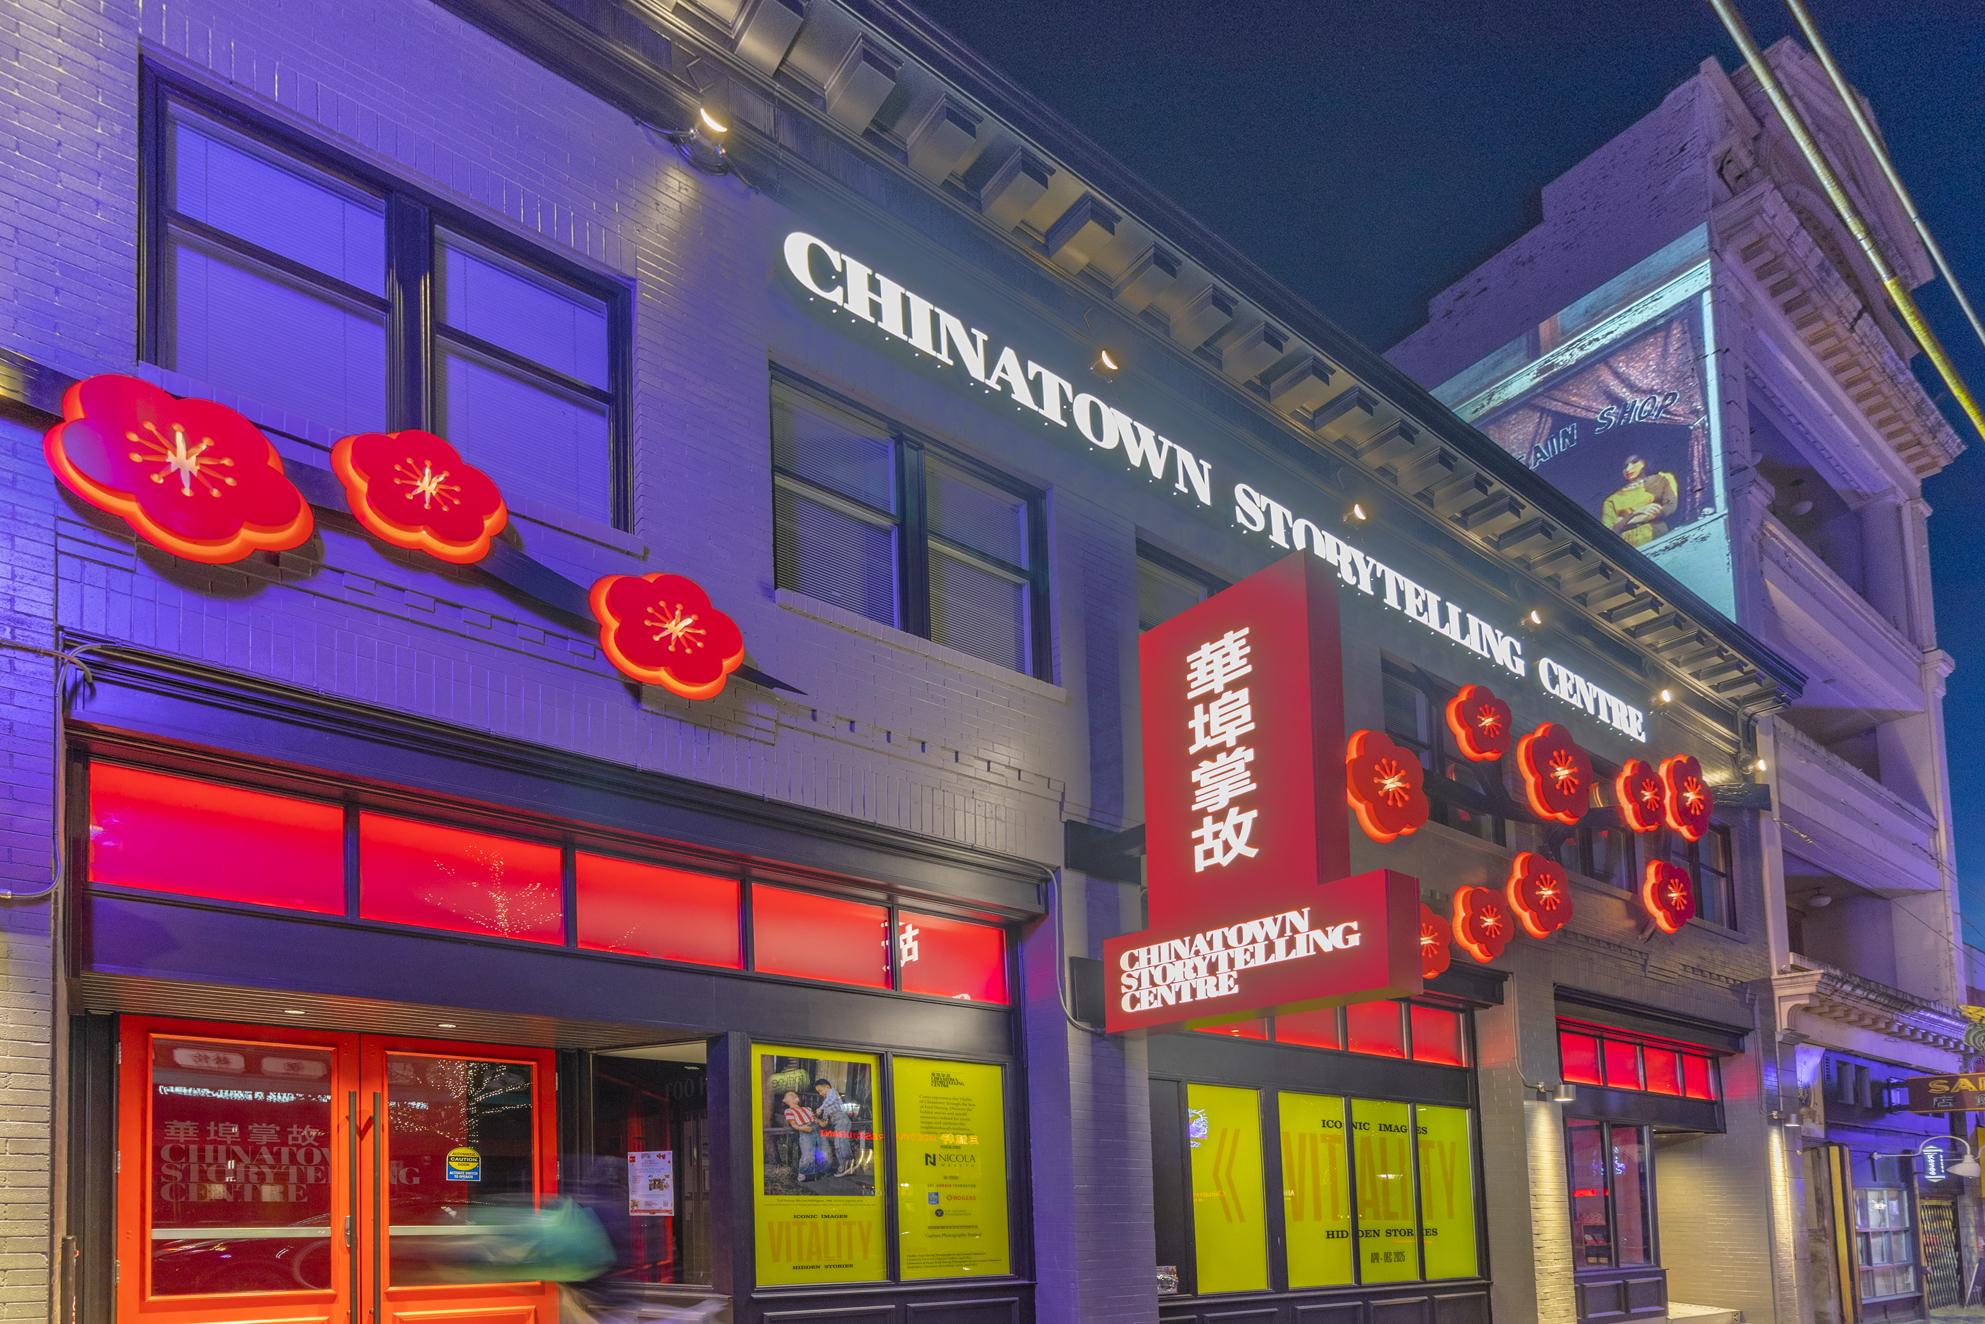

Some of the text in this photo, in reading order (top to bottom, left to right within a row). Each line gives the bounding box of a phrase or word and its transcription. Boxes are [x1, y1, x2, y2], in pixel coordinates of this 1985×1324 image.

[1594, 390, 1680, 434] SHOP
[783, 231, 1647, 744] CHINATOWN STORYTELLING CENTRE
[1186, 626, 1258, 873] 華埠掌故
[1119, 907, 1311, 973] CHINATOWN
[1120, 921, 1361, 994] STORYTELLING
[1120, 971, 1239, 1013] CENTRE
[163, 1119, 320, 1147] 華埠掌故
[160, 1143, 331, 1166] CHINATO
[939, 1154, 976, 1162] NICOLA
[160, 1183, 308, 1202] CENTRE
[1281, 1131, 1456, 1223] VITALITY
[768, 1221, 872, 1263] VITALITY
[1394, 1251, 1406, 1262] 2025
